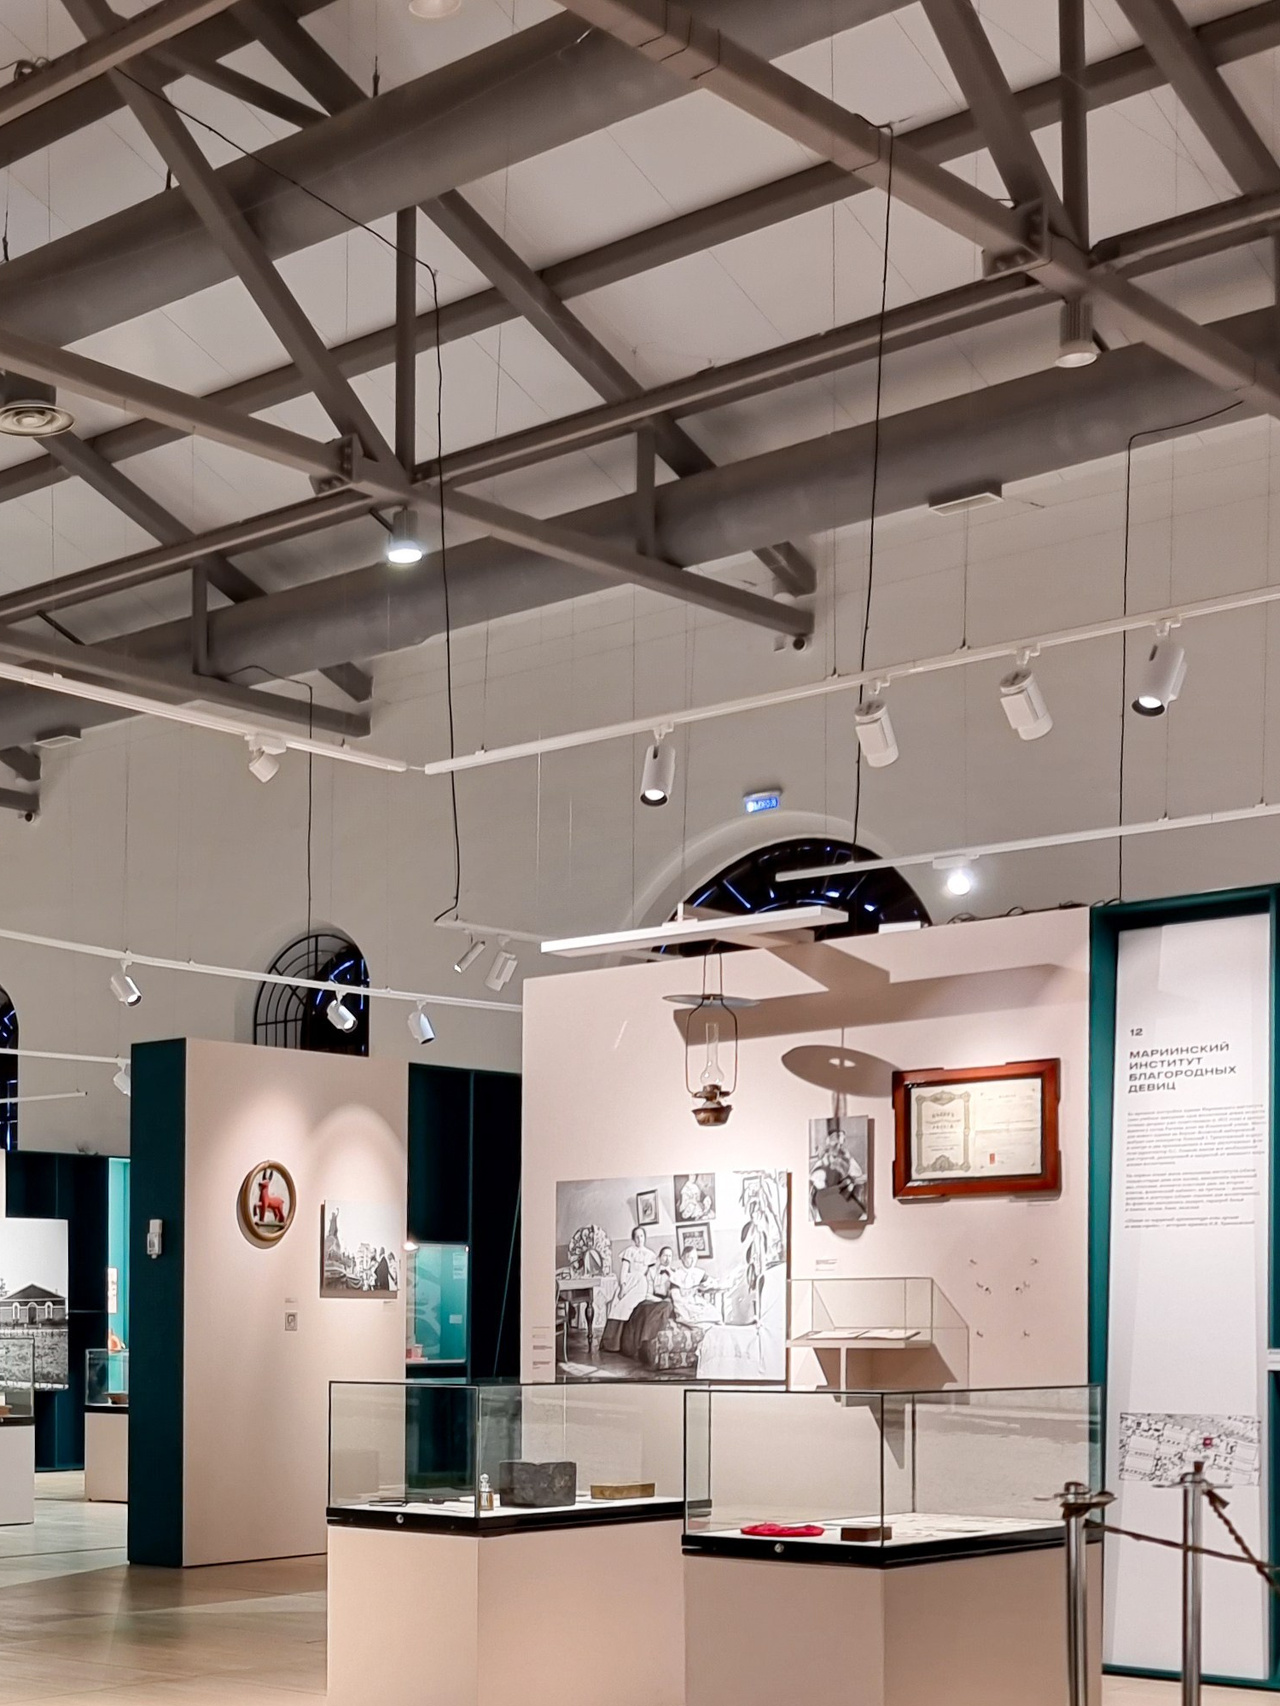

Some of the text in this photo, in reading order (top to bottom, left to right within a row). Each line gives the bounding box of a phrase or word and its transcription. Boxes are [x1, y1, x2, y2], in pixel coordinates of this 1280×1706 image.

[1130, 1028, 1143, 1036] 12
[1130, 1041, 1230, 1058] МАРИИНСКИЙ
[1130, 1057, 1203, 1070] ИНСТИТУТ
[1129, 1066, 1236, 1081] БЛАГОРОДНЫХ
[1128, 1082, 1176, 1093] ДЕВИЦ
